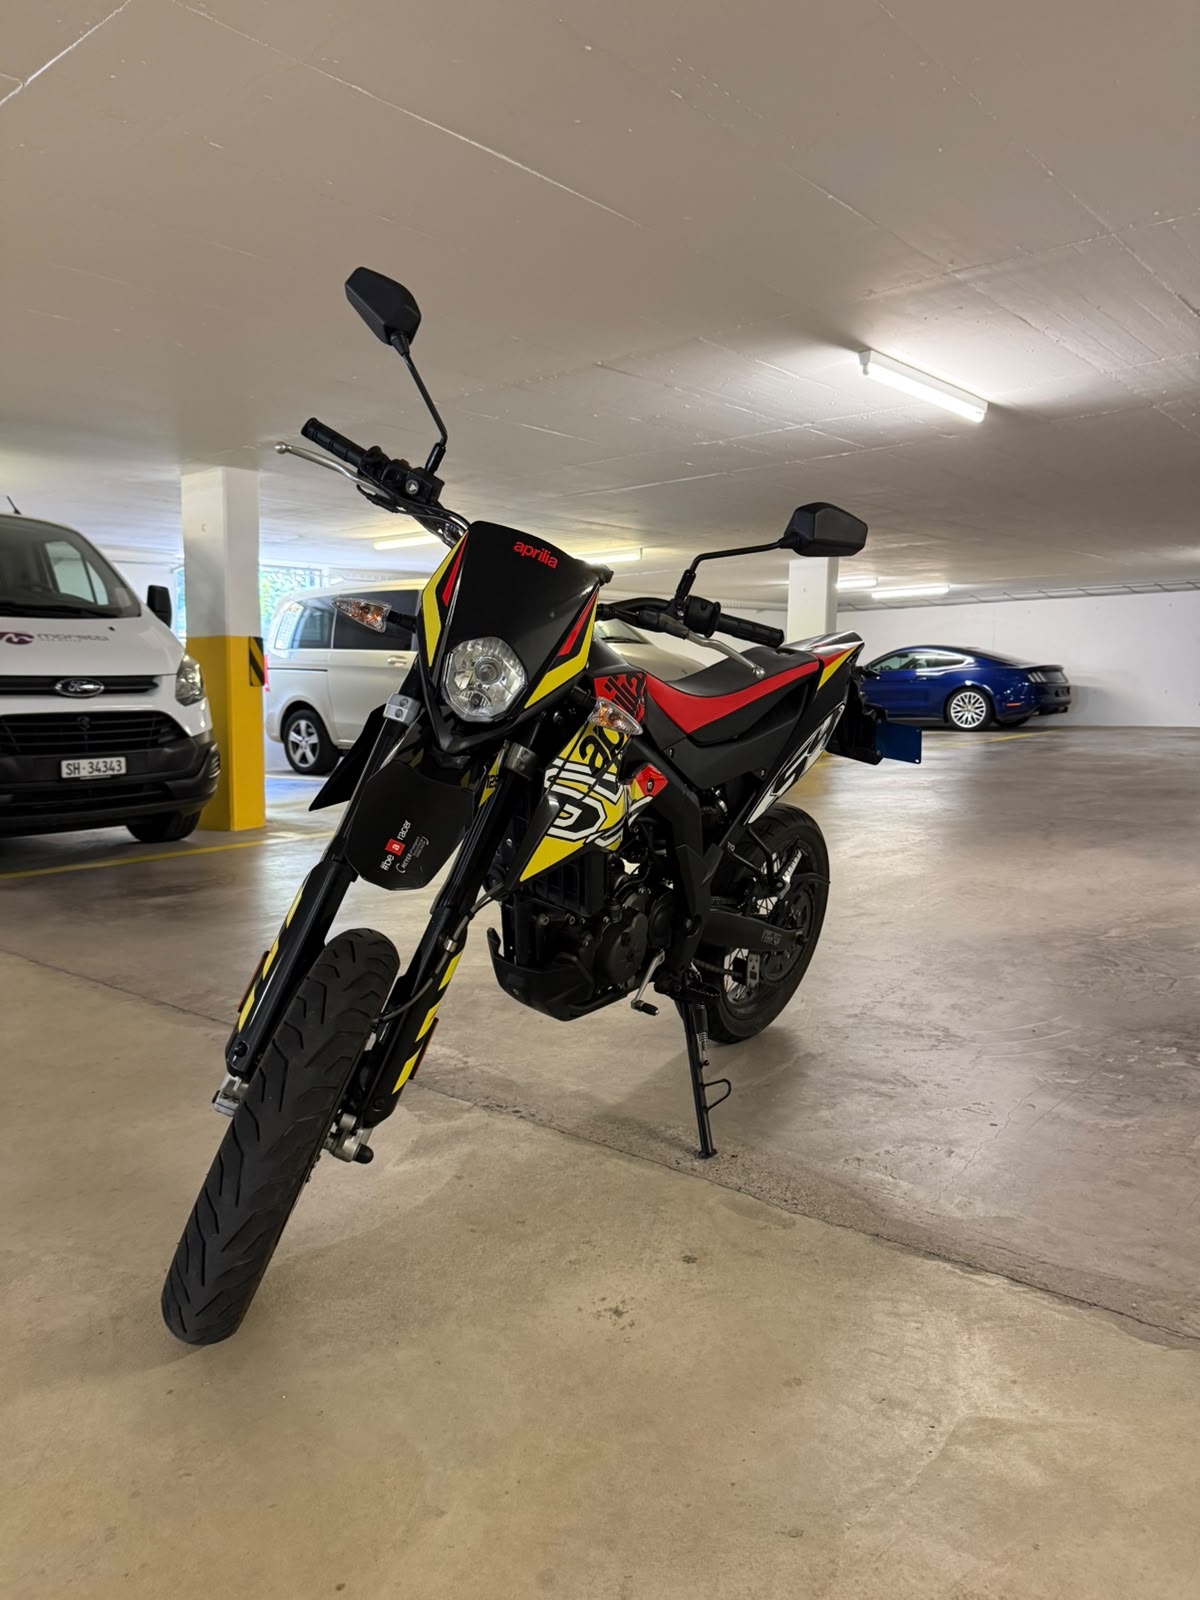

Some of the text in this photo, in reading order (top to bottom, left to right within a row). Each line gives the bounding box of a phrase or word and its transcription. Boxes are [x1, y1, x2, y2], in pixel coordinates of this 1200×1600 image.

[513, 541, 558, 569] aprilia
[380, 854, 395, 871] #be
[397, 819, 411, 841] racer
